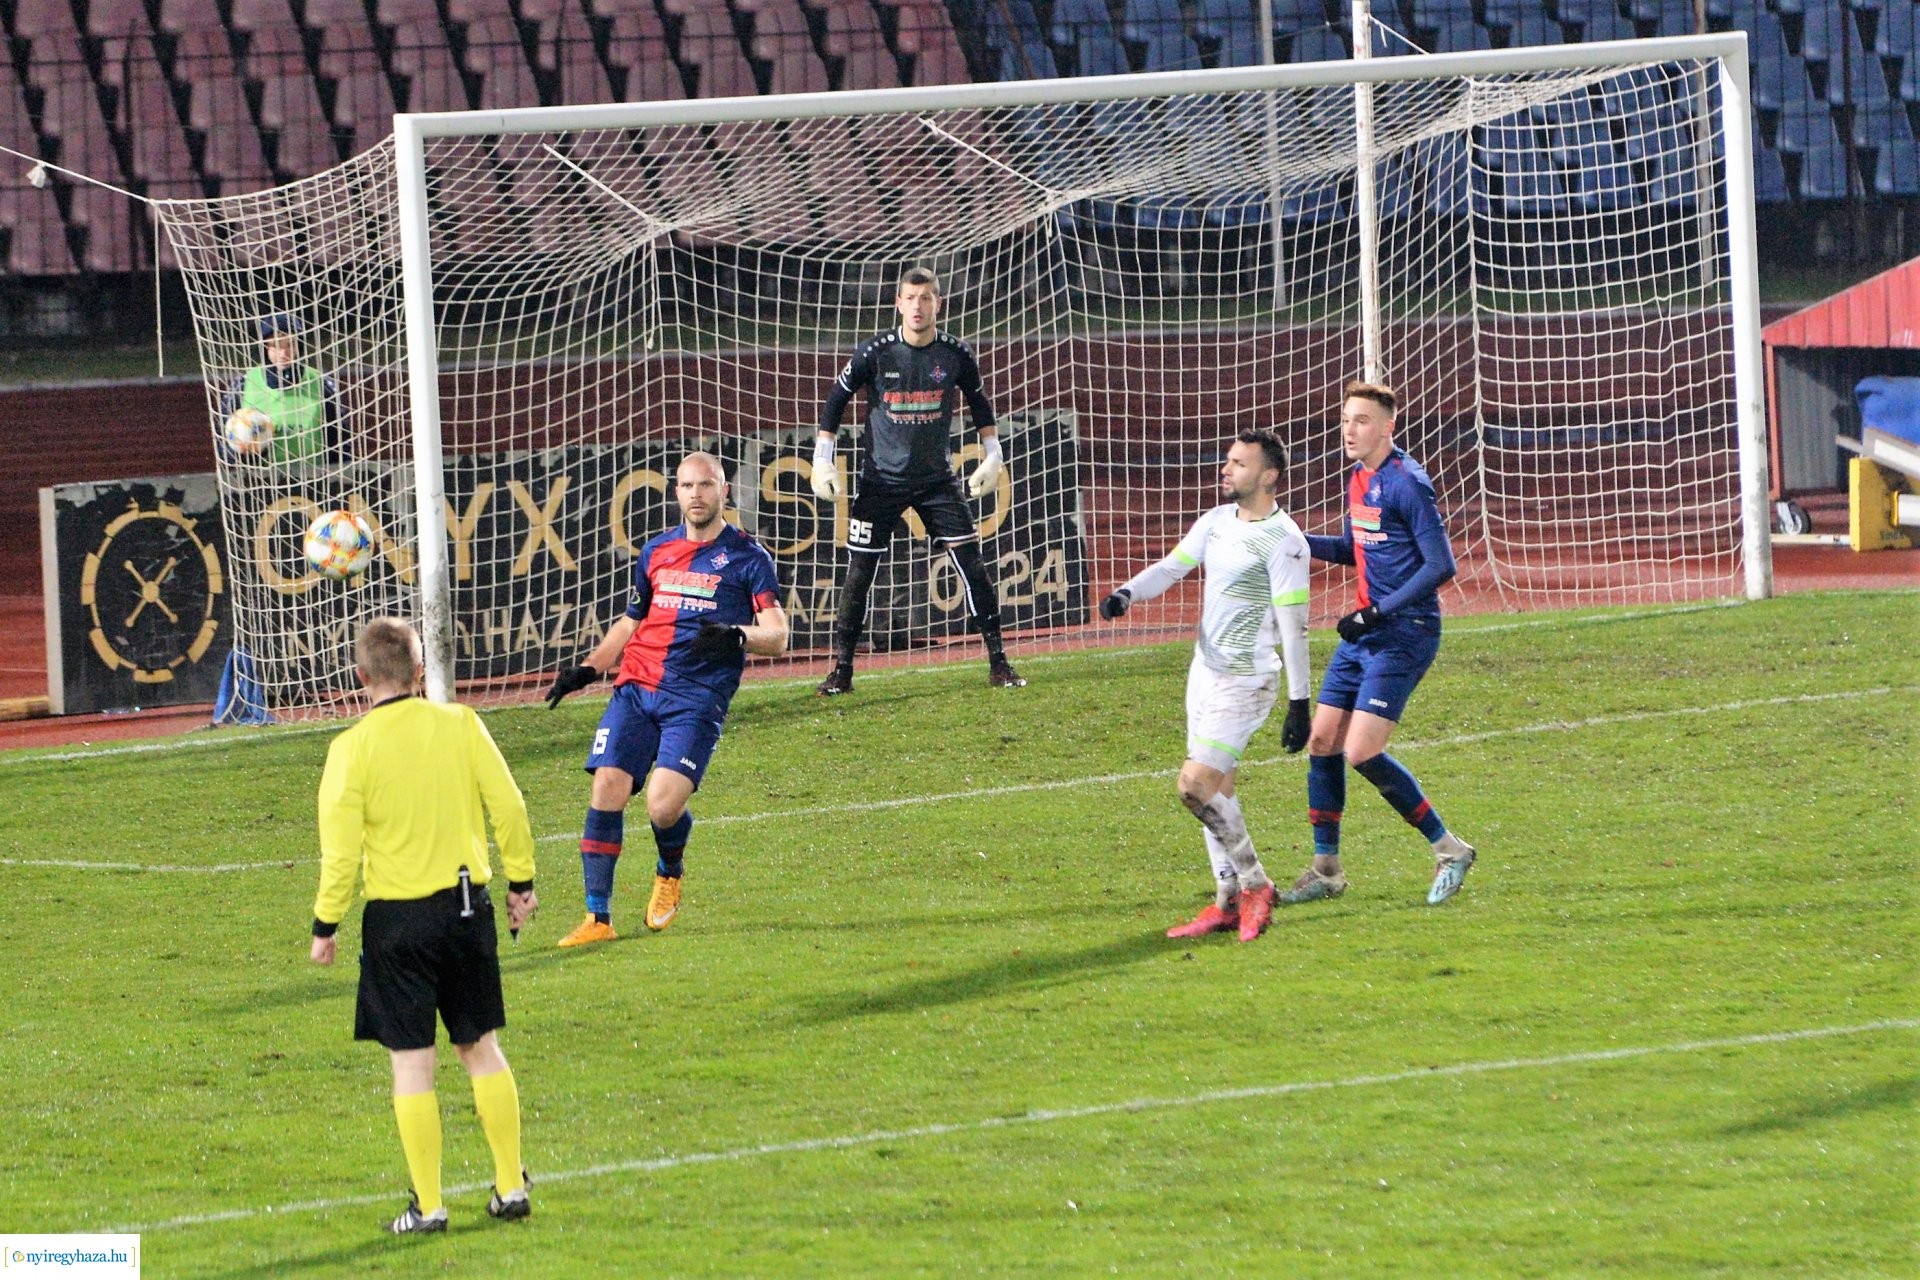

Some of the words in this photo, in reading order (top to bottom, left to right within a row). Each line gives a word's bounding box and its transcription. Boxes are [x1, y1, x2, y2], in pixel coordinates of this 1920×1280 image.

[609, 443, 1012, 556] CSIO
[850, 518, 873, 544] 95
[1369, 698, 1388, 708] JAKO
[680, 757, 697, 771] JAKO
